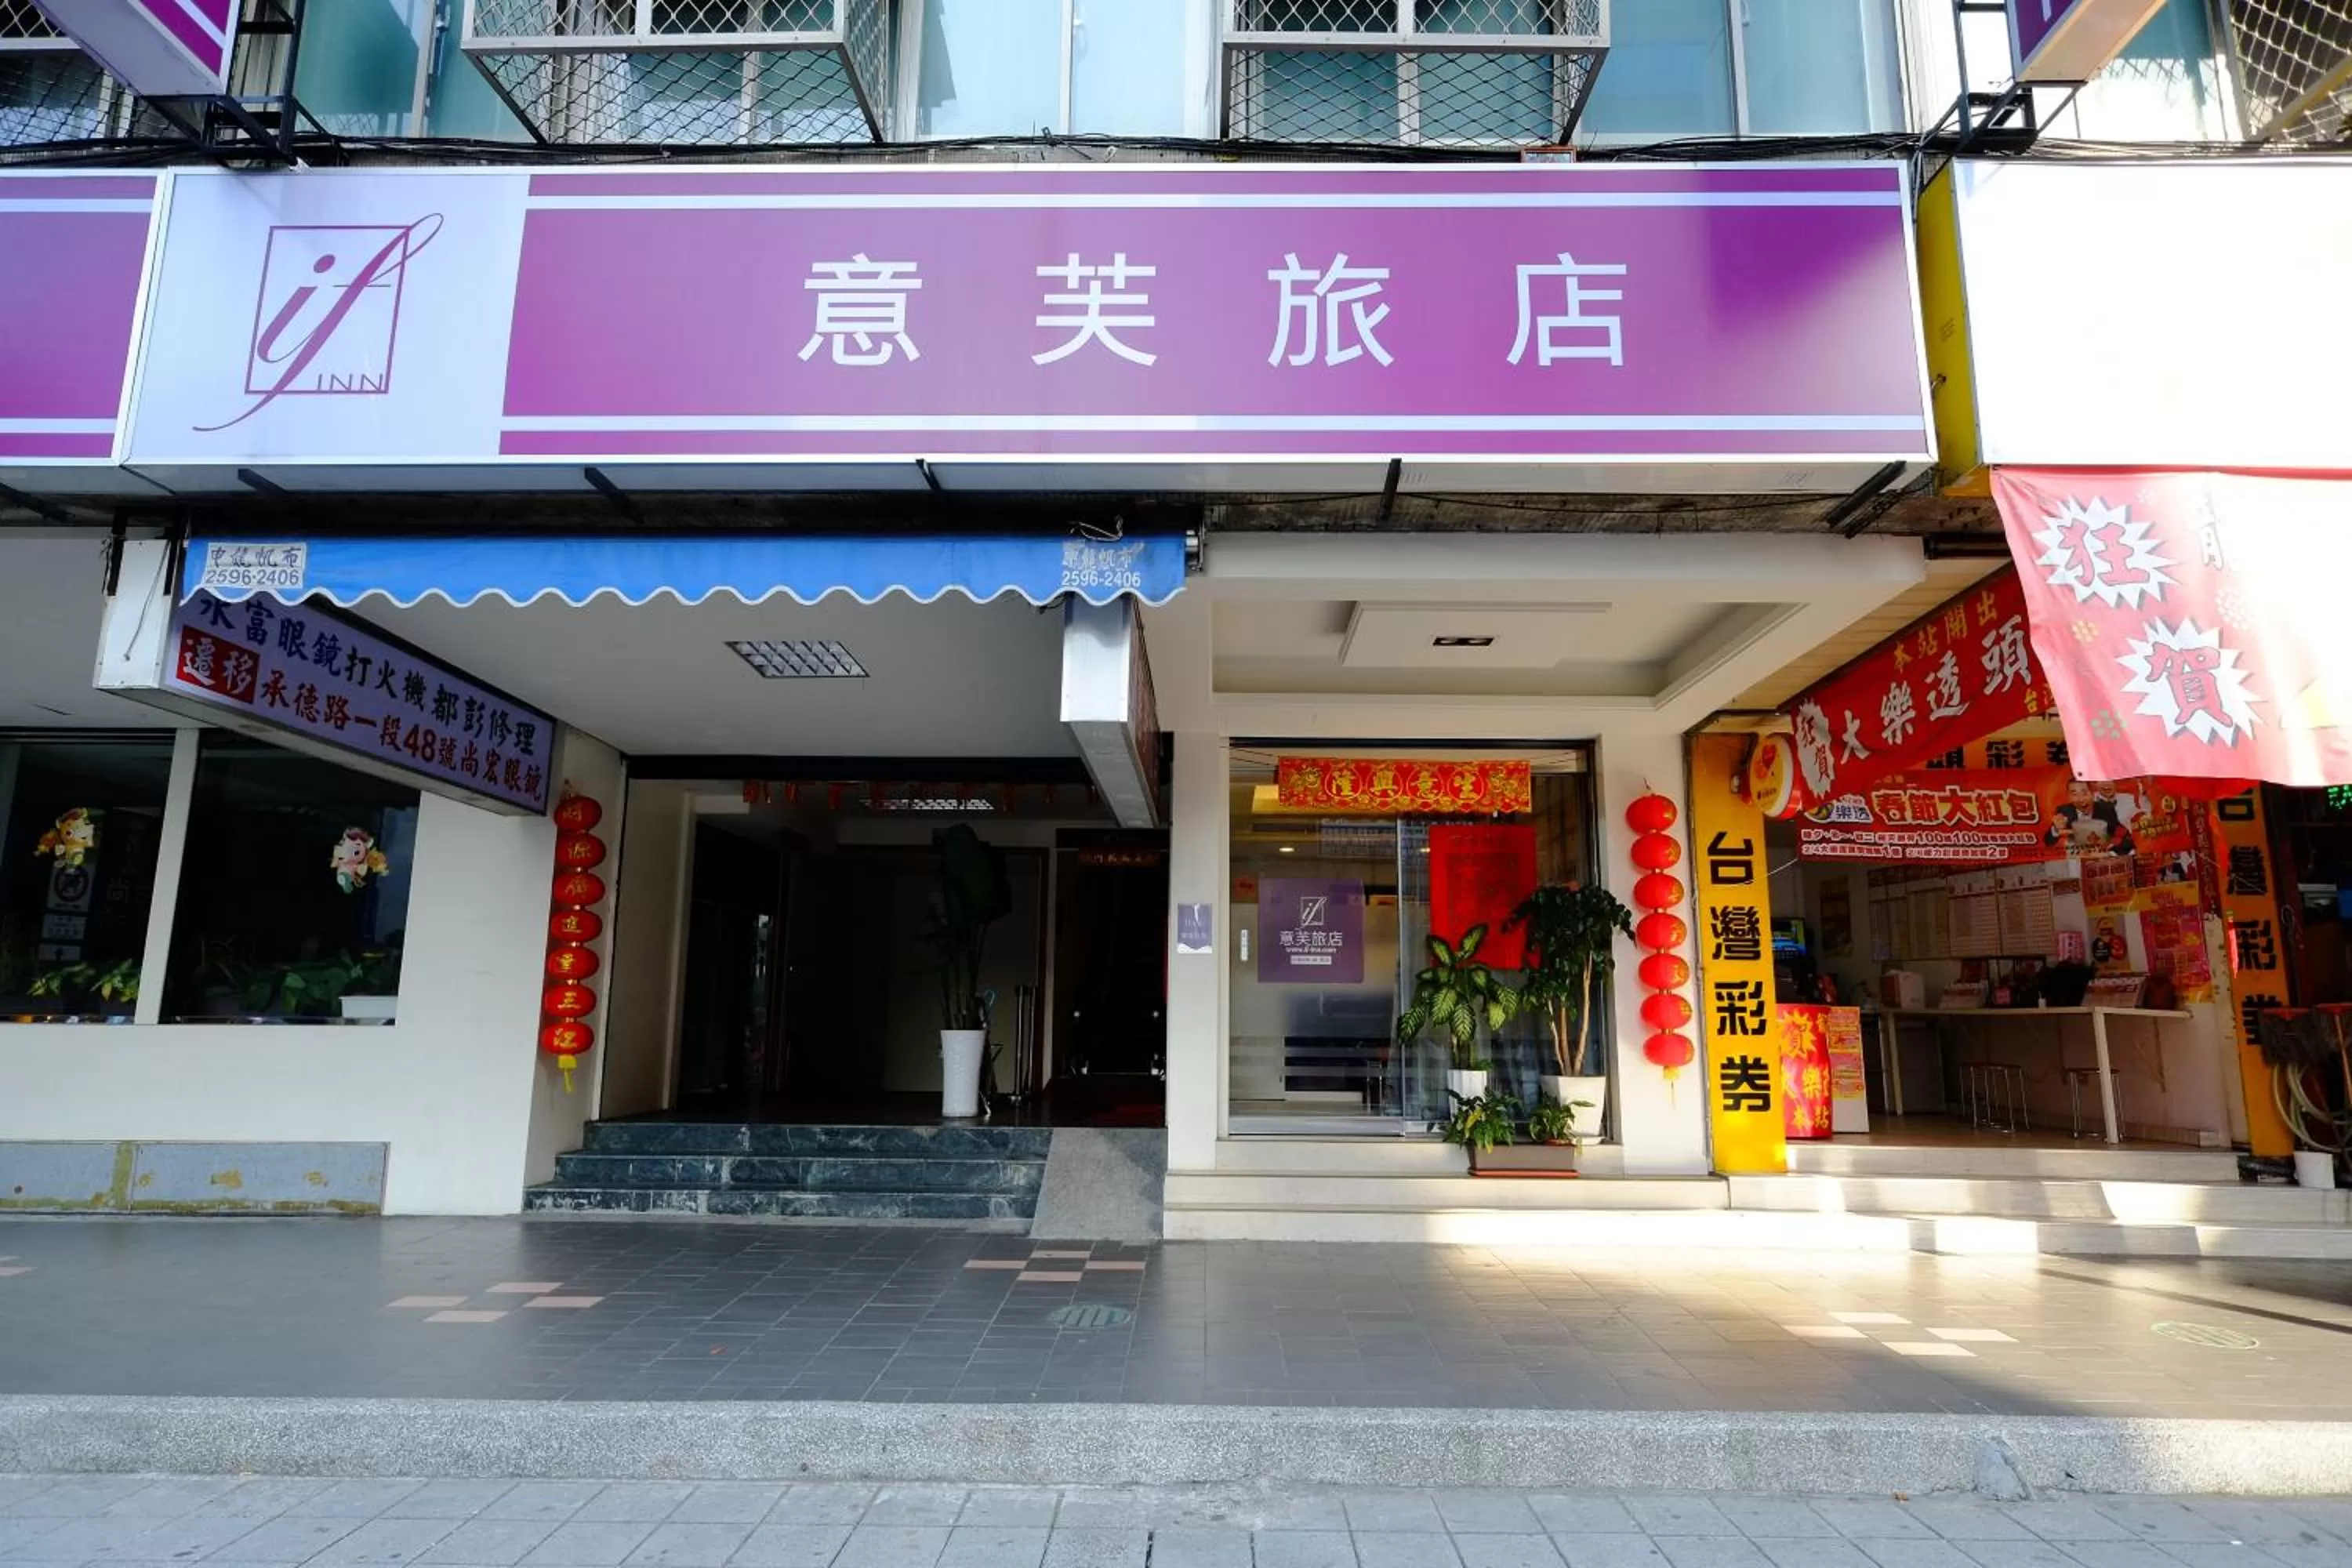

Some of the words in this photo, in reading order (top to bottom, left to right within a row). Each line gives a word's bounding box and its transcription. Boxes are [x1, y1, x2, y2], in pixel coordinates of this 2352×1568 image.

[797, 252, 1628, 368] 意芙旅店
[316, 373, 383, 391] INN
[1062, 571, 1142, 587] 2596-2406
[183, 637, 255, 695] 遷移
[1875, 787, 2038, 824] 春節大紅包
[1279, 930, 1343, 946] 意芙旅店
[1707, 830, 1772, 1112] 台灣彩券
